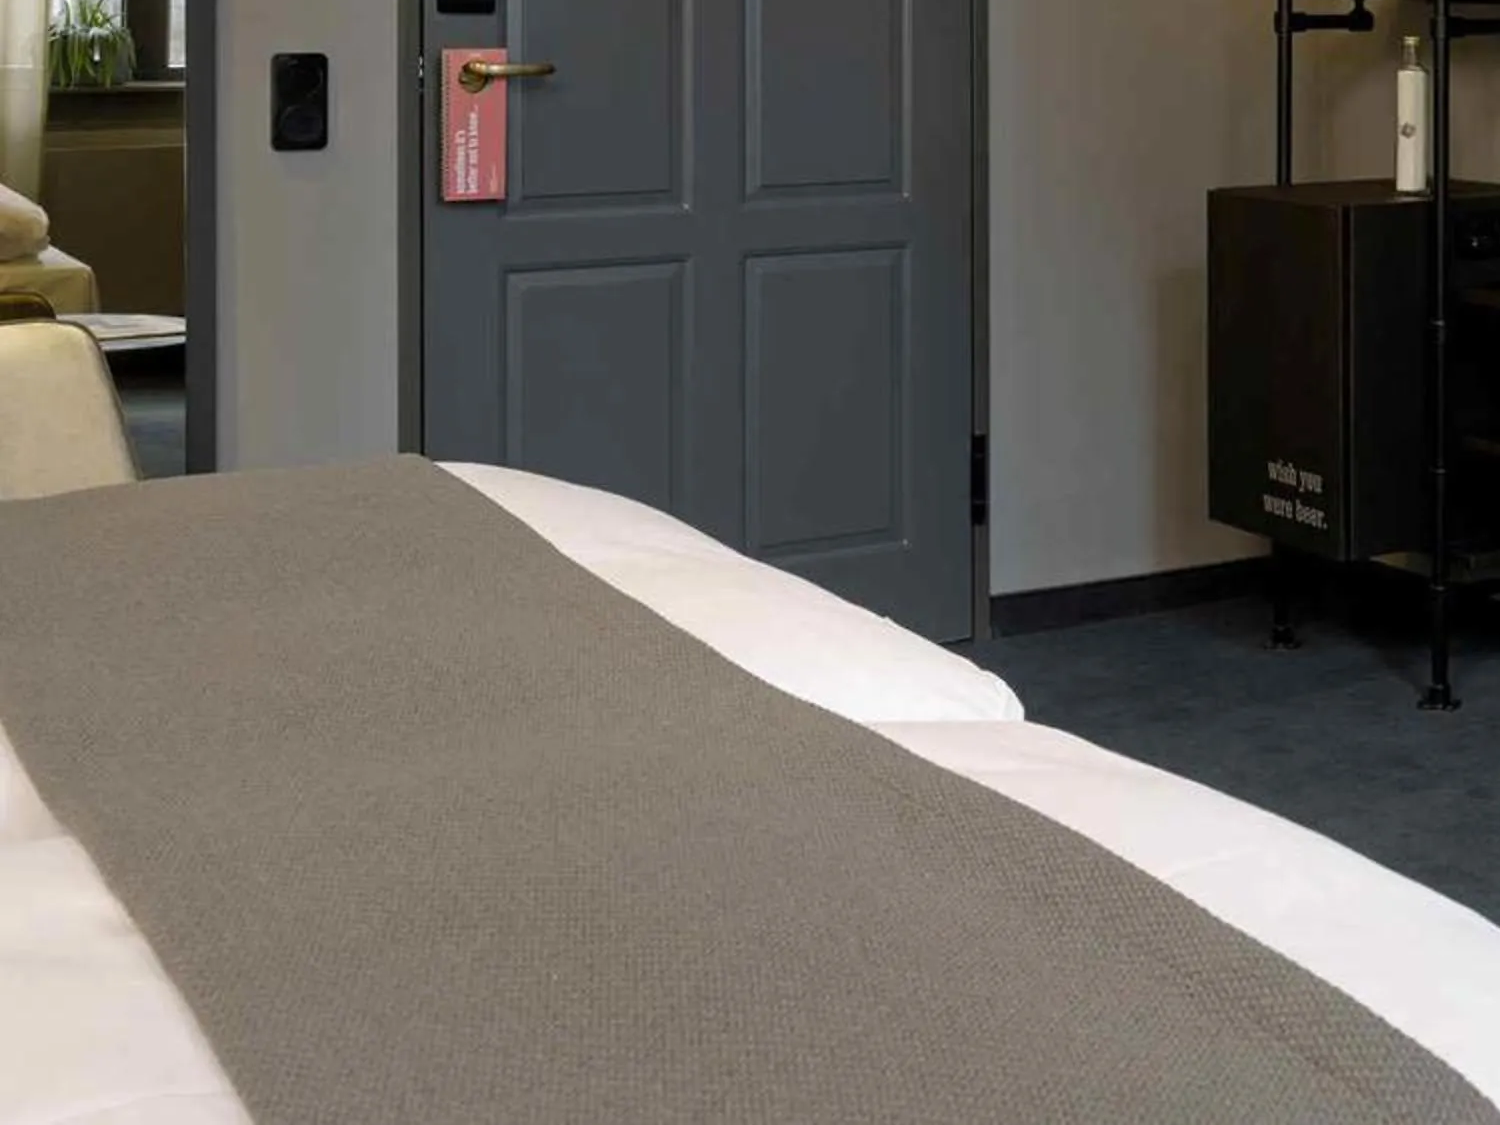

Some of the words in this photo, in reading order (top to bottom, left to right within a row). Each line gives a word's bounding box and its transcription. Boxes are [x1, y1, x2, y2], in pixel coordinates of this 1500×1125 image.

[1267, 458, 1298, 487] wish
[1298, 470, 1324, 494] you
[1262, 493, 1294, 519] were
[1295, 498, 1329, 531] beer.
